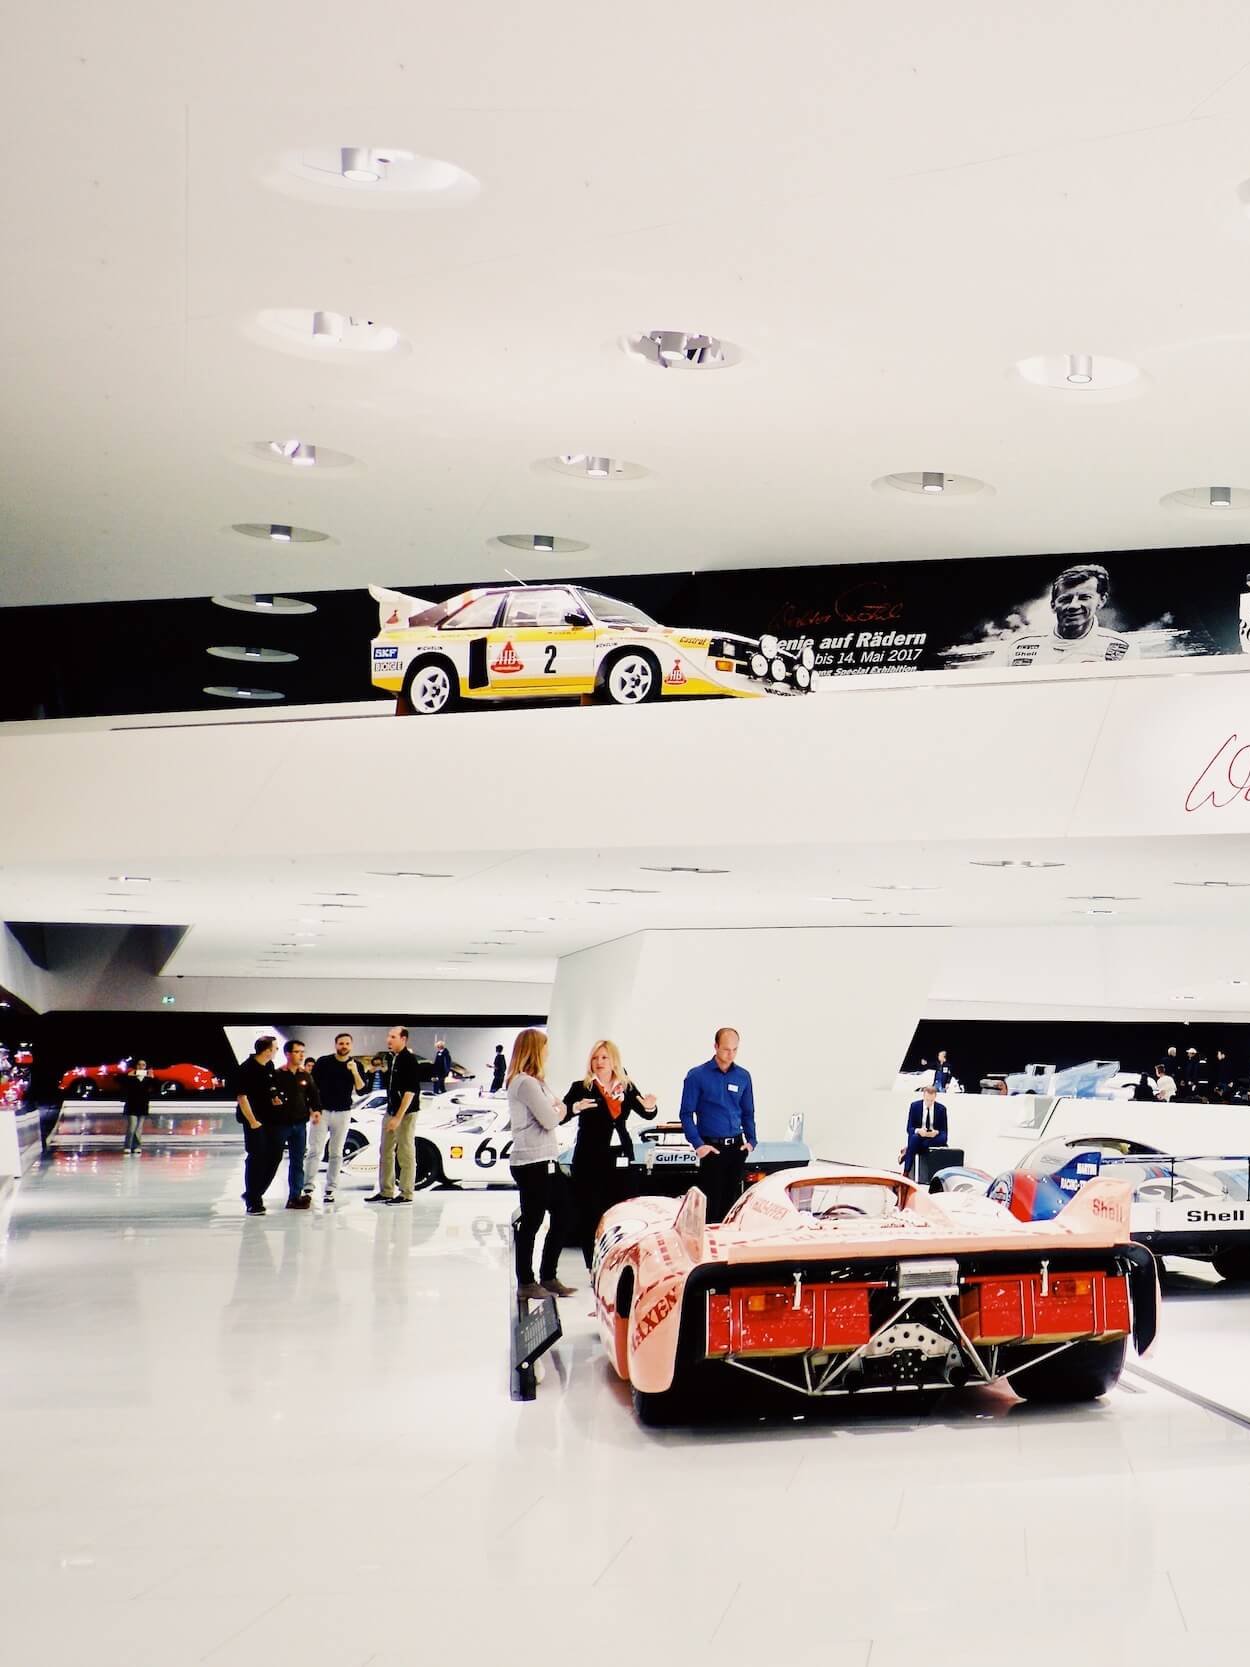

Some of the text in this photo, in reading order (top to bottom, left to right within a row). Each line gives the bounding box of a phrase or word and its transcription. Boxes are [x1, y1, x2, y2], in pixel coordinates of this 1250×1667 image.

[679, 636, 708, 646] Castrol
[776, 631, 927, 651] enie auf Rädern
[374, 648, 398, 659] SKF
[543, 644, 557, 674] 2
[815, 649, 923, 665] bis 14. Mai 2017
[655, 1153, 698, 1163] Gulf-Po
[1092, 1198, 1123, 1224] Shell
[1186, 1209, 1245, 1223] Shell
